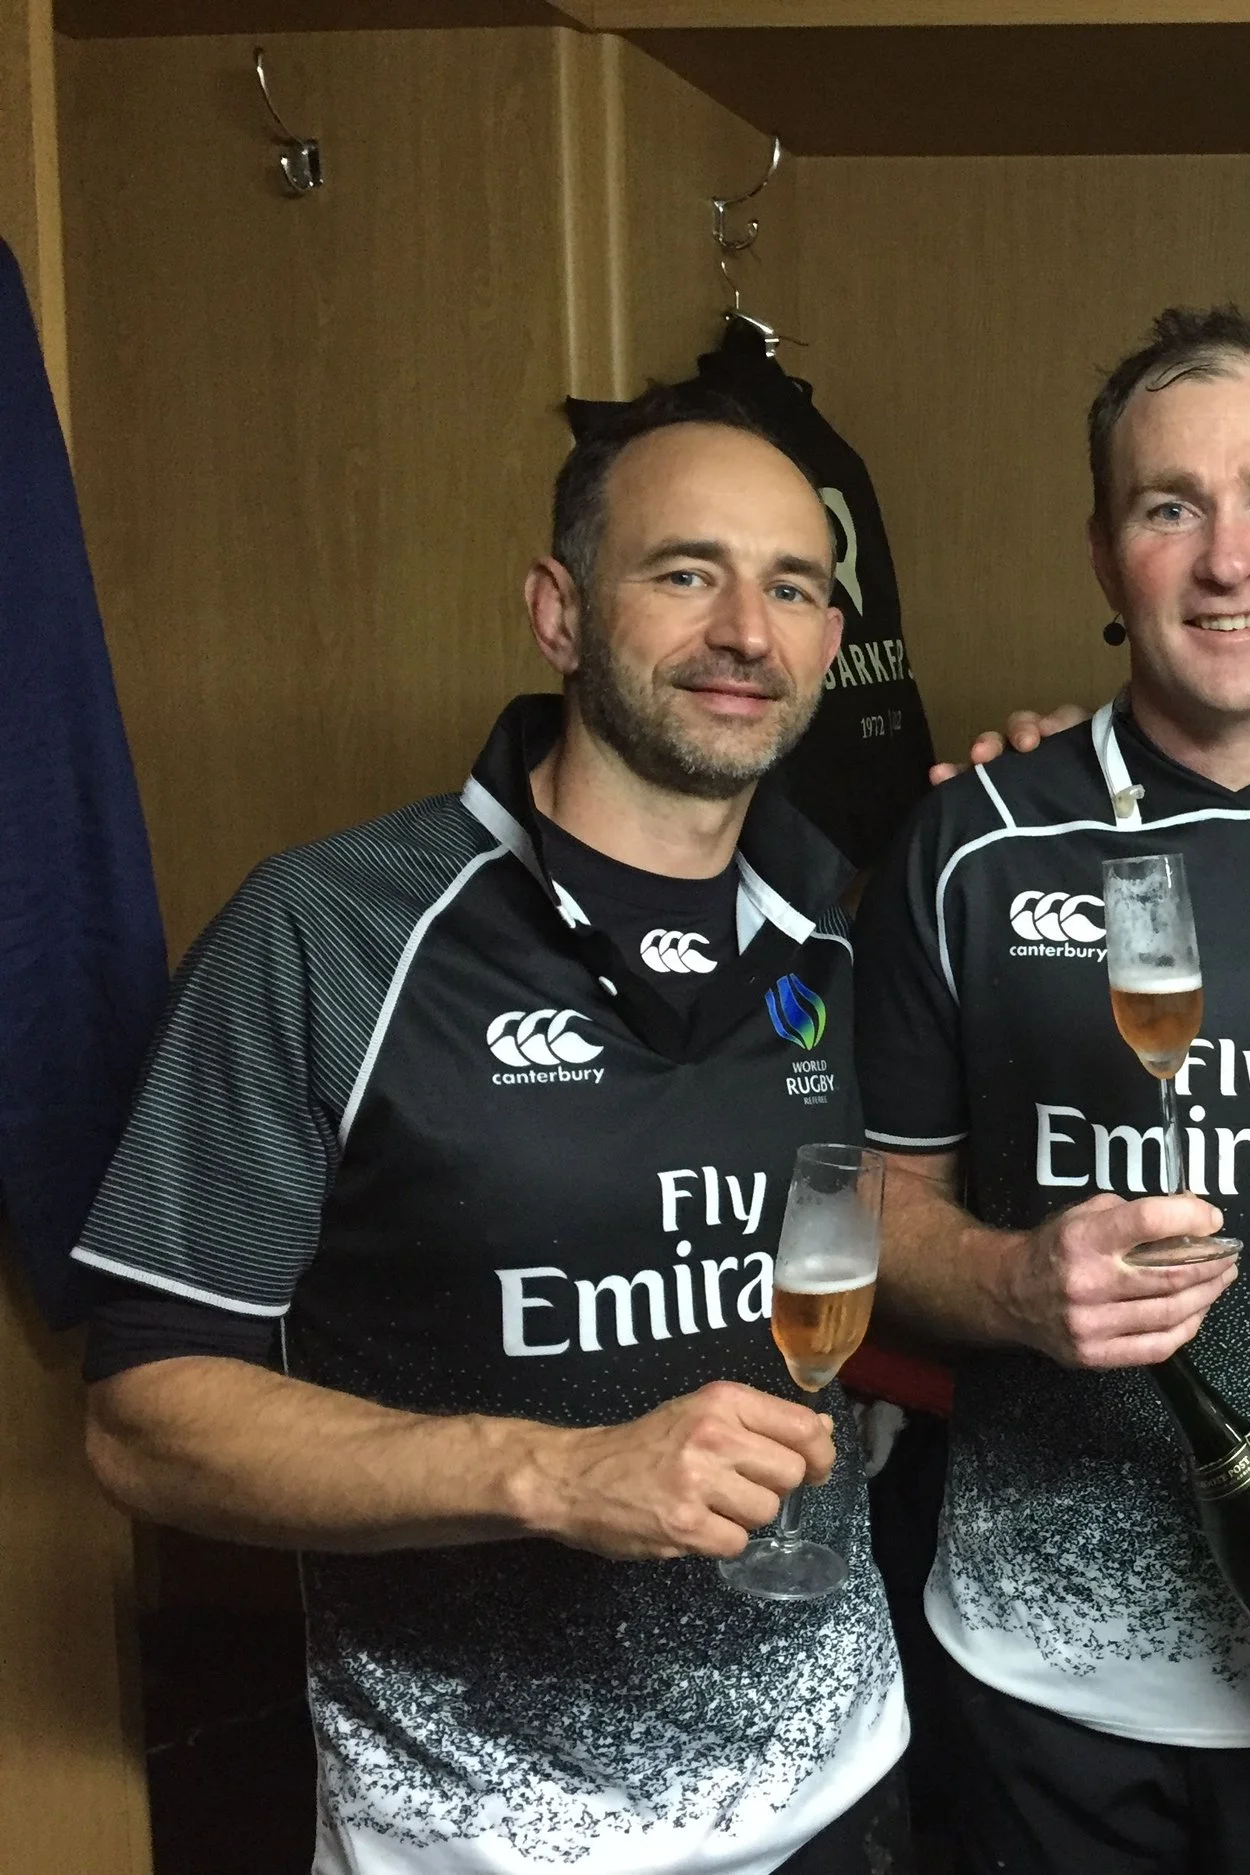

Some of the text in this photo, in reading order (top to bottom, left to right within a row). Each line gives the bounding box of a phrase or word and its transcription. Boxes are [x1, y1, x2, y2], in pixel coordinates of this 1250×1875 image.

[860, 714, 886, 739] 1972
[1009, 943, 1108, 962] canterbury
[491, 1066, 605, 1085] canterbury
[792, 1059, 828, 1074] WORLD
[786, 1074, 835, 1095] RUGBY
[657, 1166, 767, 1235] Fly
[494, 1240, 776, 1357] Emira
[1228, 1455, 1250, 1478] POST
